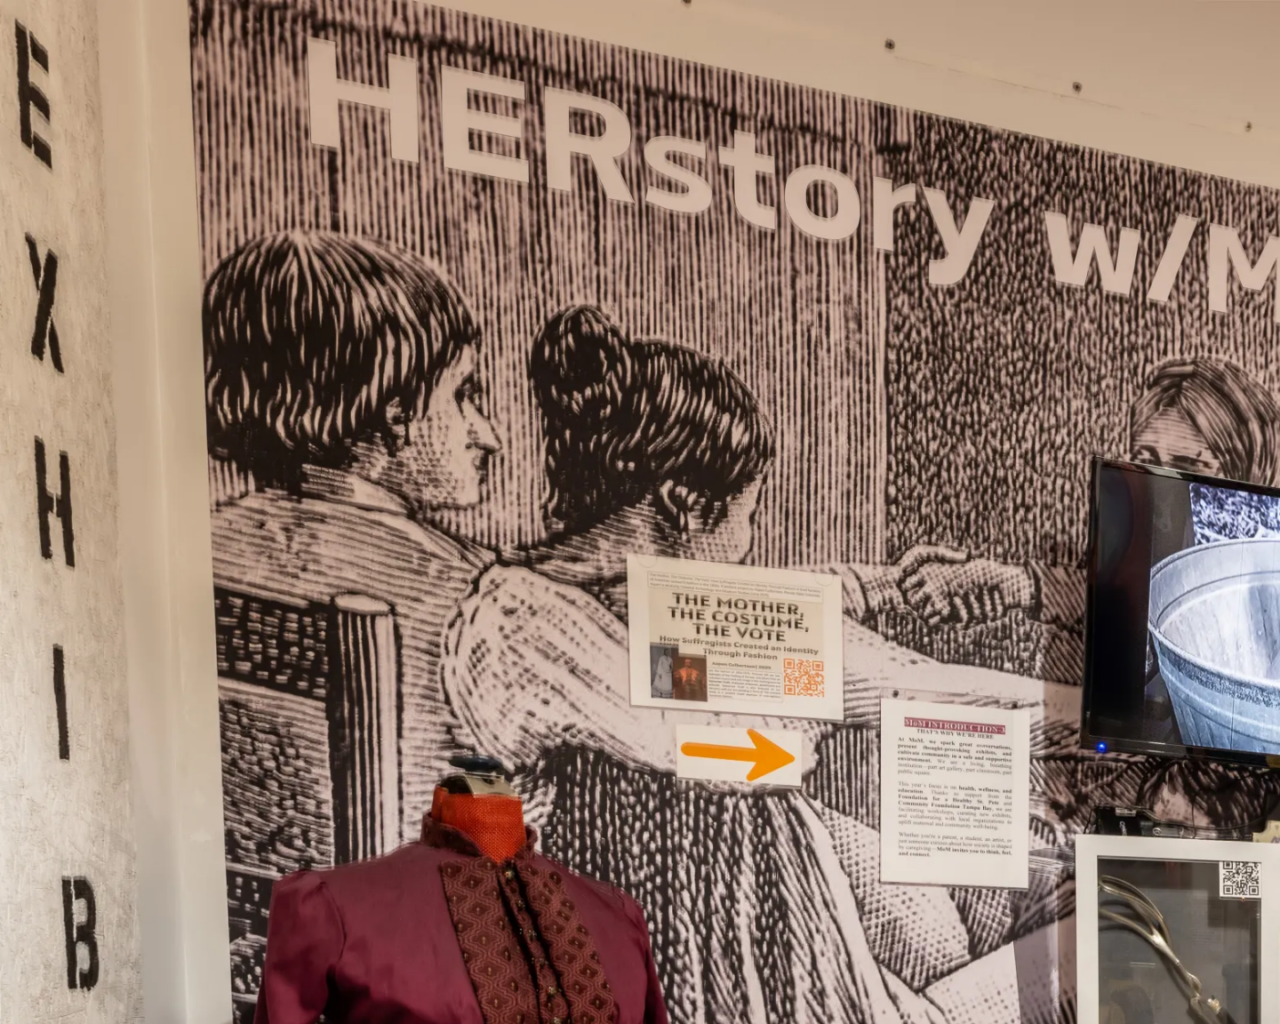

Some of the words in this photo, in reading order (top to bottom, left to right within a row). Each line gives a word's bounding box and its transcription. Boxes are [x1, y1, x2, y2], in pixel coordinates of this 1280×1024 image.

[306, 36, 996, 287] HERstory
[672, 592, 711, 607] THE
[717, 596, 804, 618] MOTHER,
[667, 606, 706, 621] THE
[711, 610, 809, 632] COSTUME,
[692, 622, 731, 637] THE
[736, 627, 786, 642] VOTE
[659, 635, 681, 644] How
[682, 636, 731, 650] Suffragists
[733, 641, 769, 651] Created
[783, 646, 819, 657] Identity
[703, 648, 742, 659] Through
[743, 651, 778, 661] Fashion
